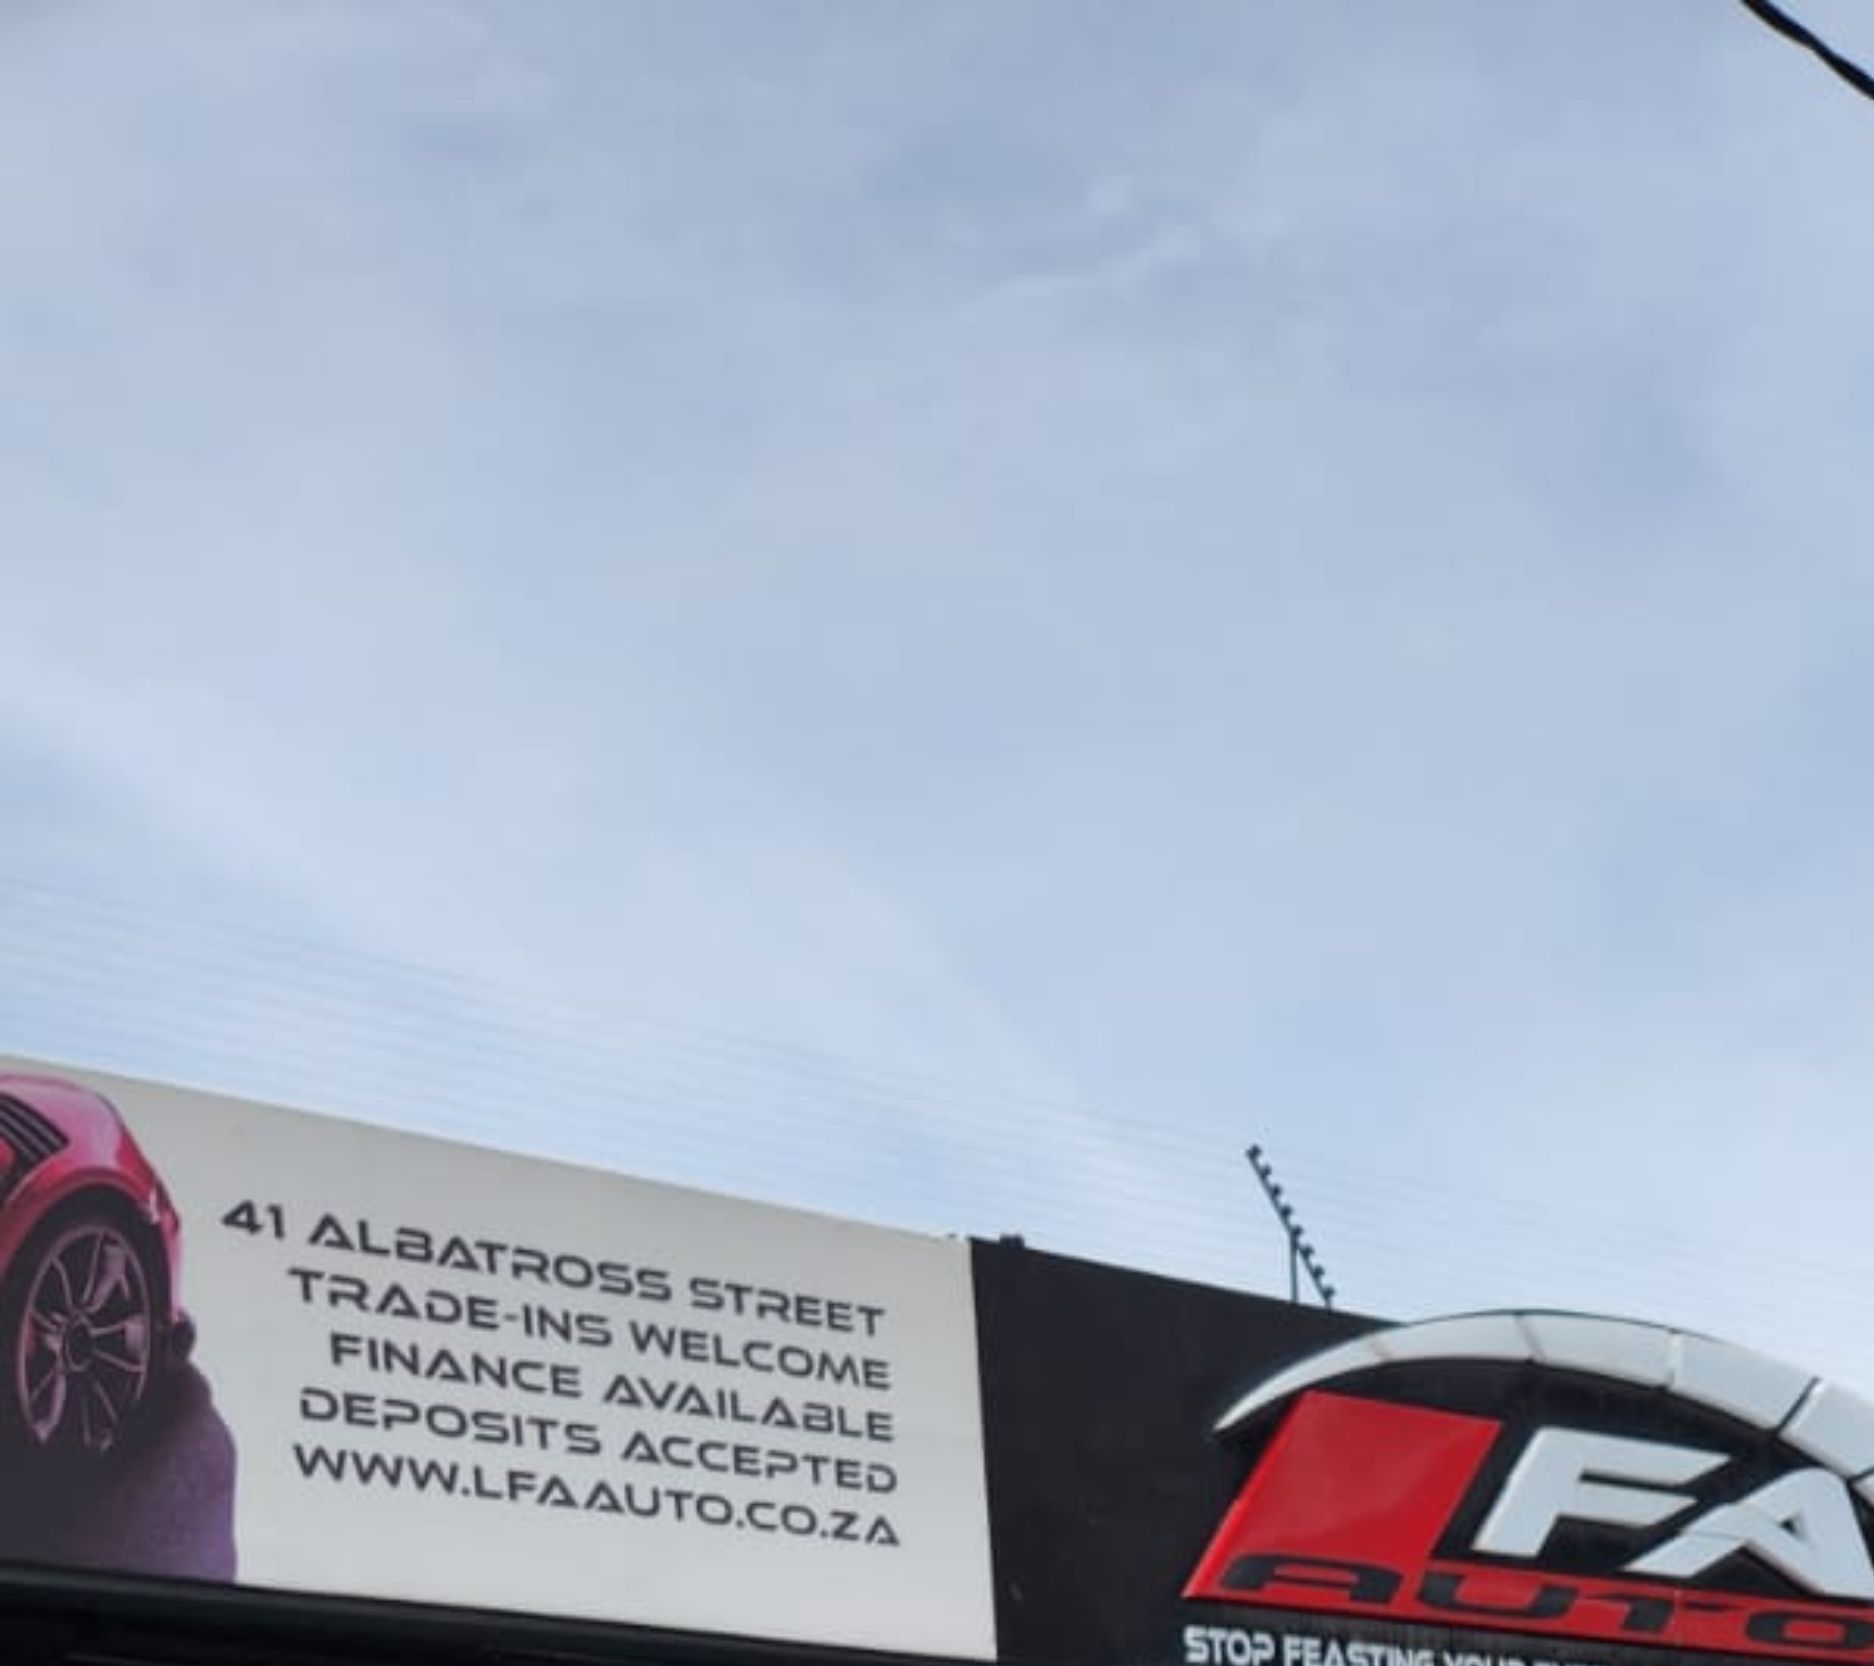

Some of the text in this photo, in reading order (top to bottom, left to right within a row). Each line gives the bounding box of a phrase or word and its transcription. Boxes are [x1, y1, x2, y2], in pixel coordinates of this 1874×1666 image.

[221, 1199, 885, 1337] 41 ALBATROSS STREET
[288, 1267, 890, 1390] TRADE-INS WELCOME
[300, 1386, 897, 1494] DEPOSITS ACCEPTED
[330, 1332, 893, 1442] FINANCE AVAILABLE
[293, 1444, 899, 1546] WWW.LFAAUTO.CO.ZA
